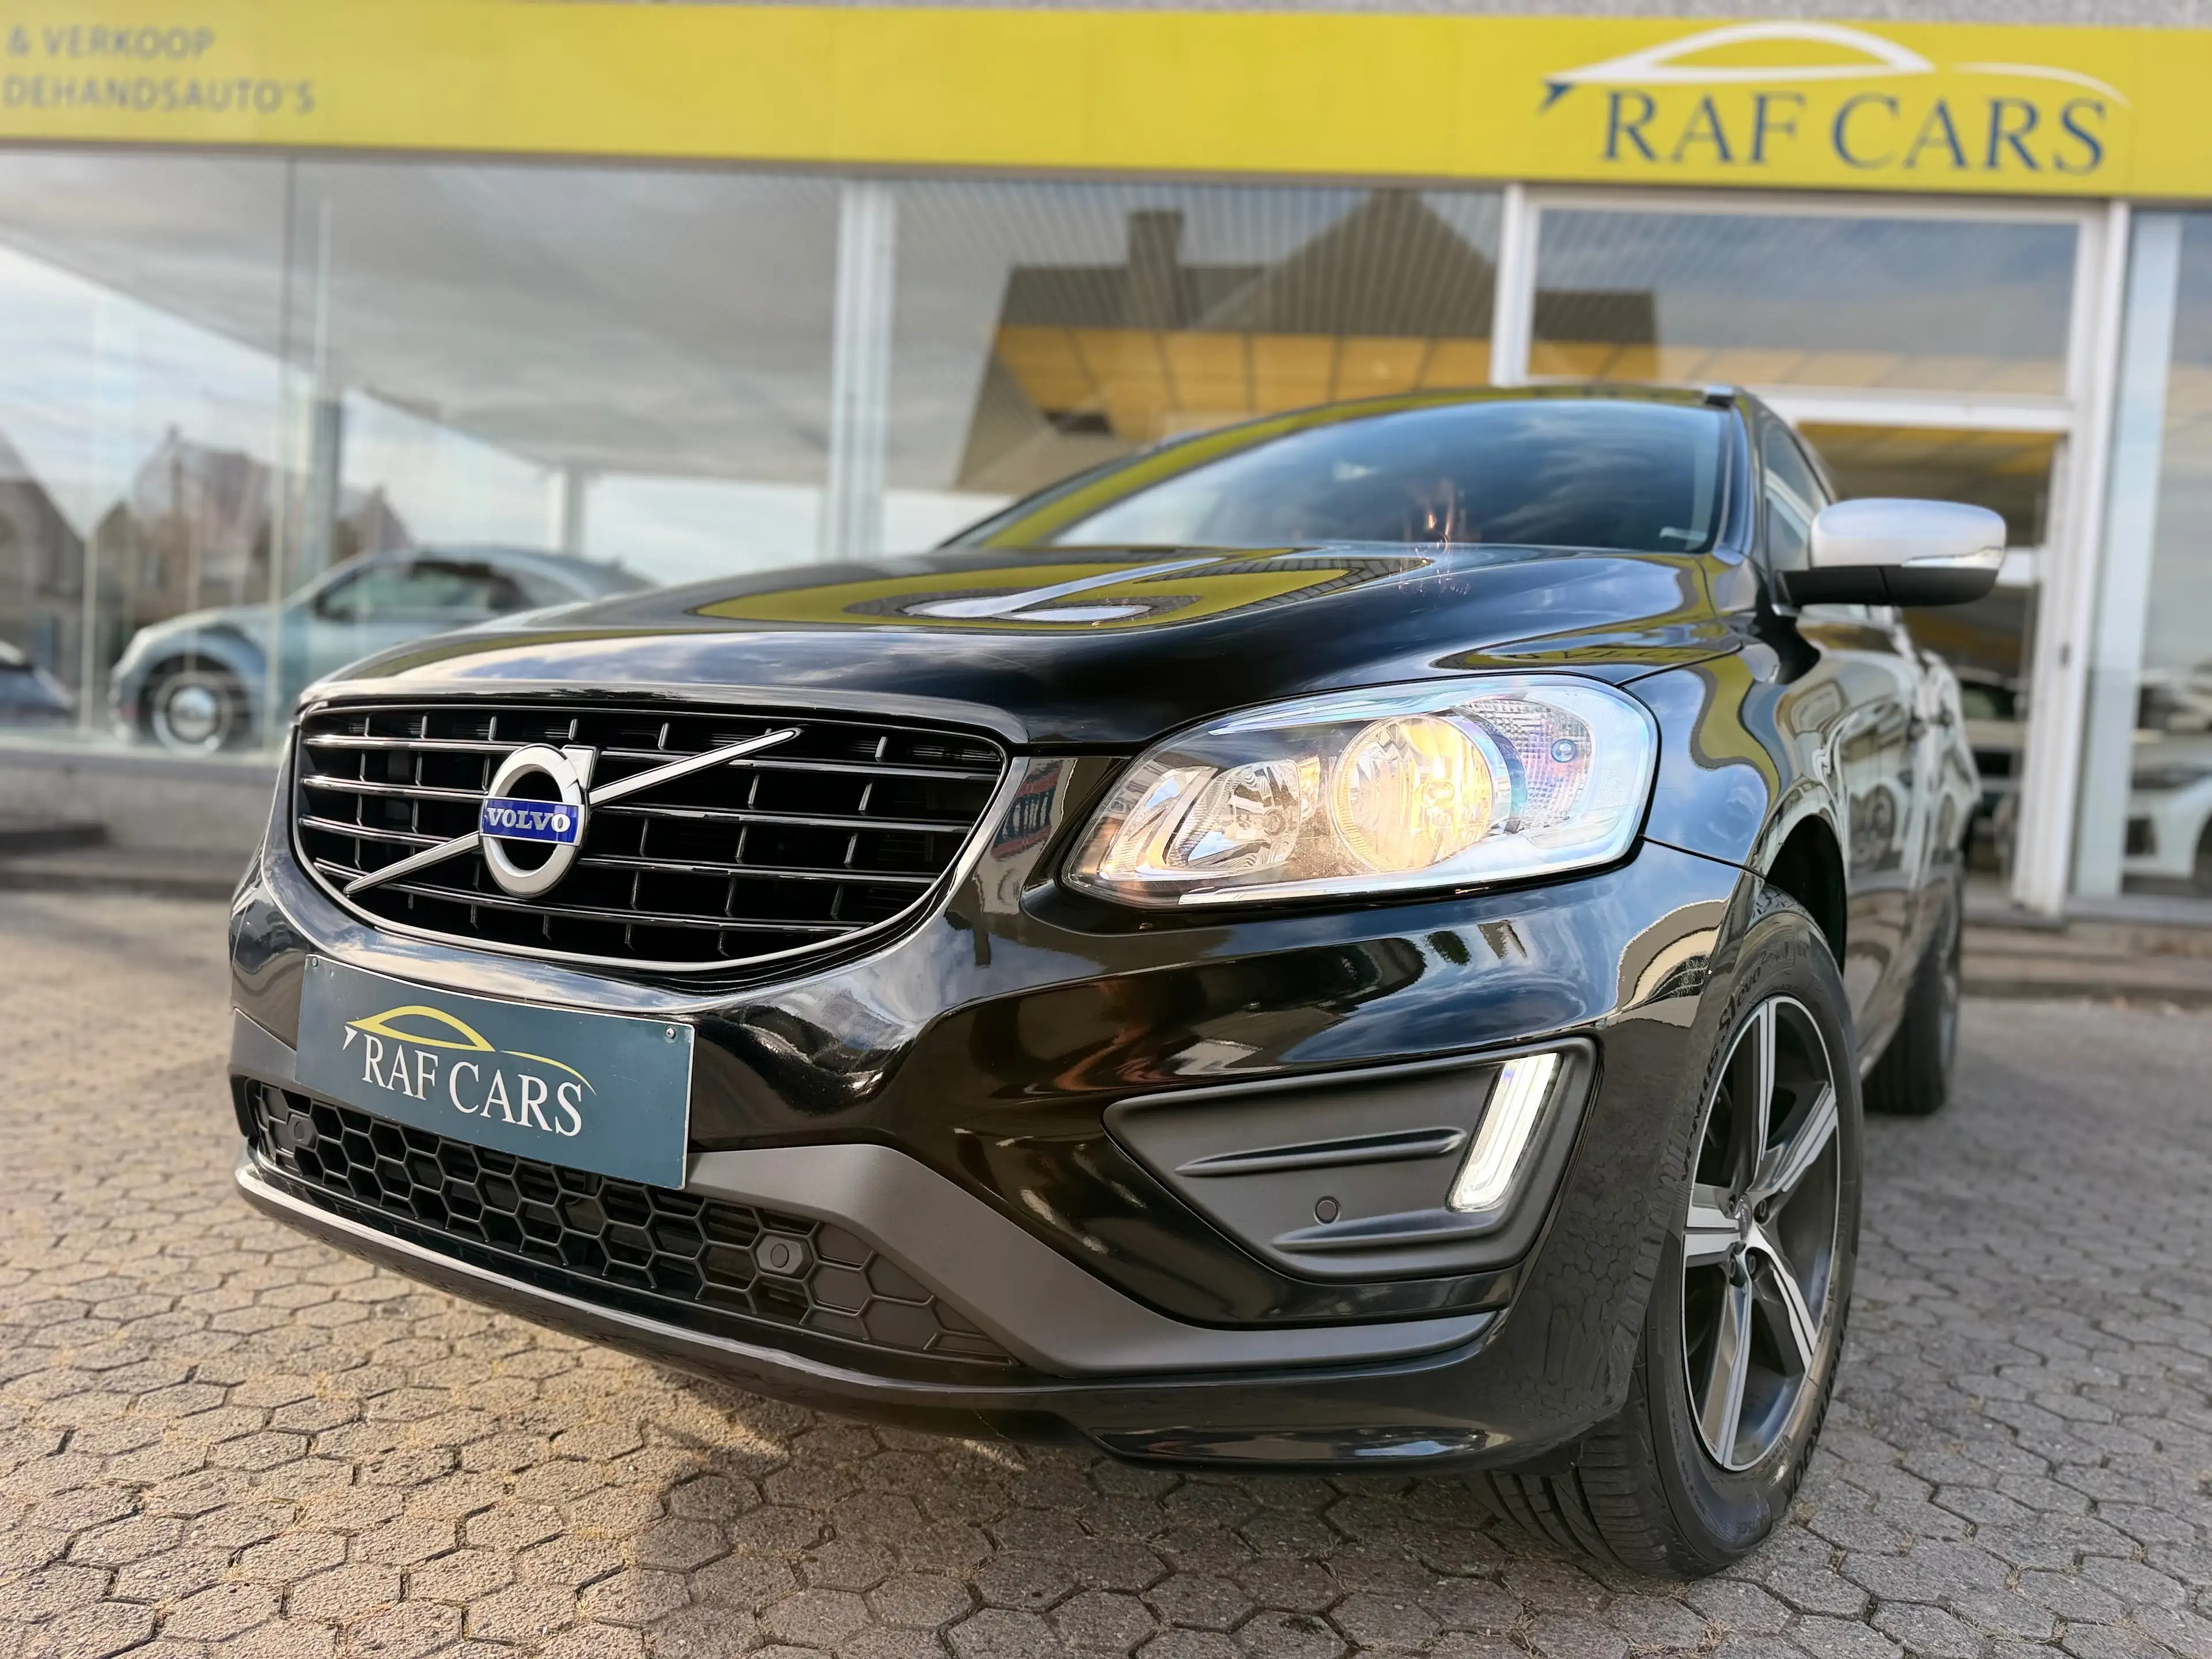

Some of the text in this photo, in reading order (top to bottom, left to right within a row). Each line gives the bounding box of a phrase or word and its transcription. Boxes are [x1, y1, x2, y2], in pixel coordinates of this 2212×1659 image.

[6, 24, 216, 60] & VERKOOP
[1599, 88, 2107, 177] RAF CARS
[487, 807, 571, 833] VOLVO
[362, 1033, 583, 1137] RAF CARS
